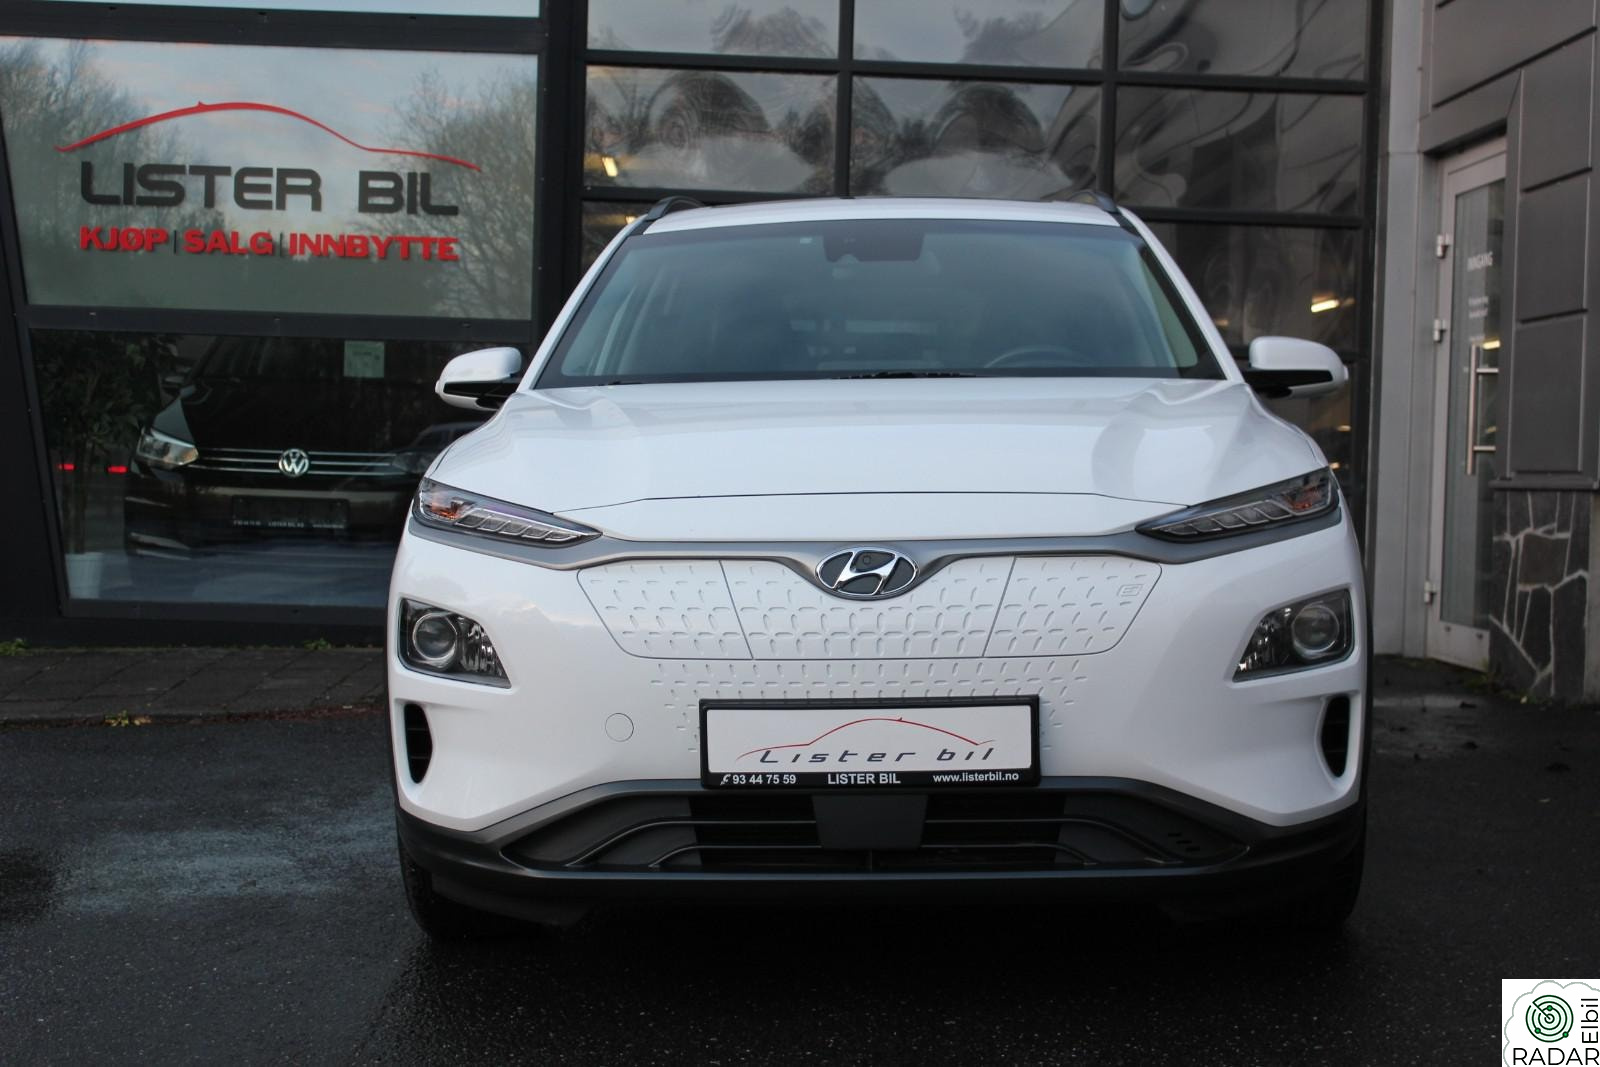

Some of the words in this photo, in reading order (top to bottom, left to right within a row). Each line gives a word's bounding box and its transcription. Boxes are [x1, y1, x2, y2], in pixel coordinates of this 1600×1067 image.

[80, 161, 322, 212] LISTER
[358, 170, 459, 216] BIL
[79, 226, 168, 252] KJØP
[183, 230, 274, 257] SALG
[288, 233, 459, 261] INNBYTTE
[759, 750, 916, 763] Lister
[936, 748, 994, 761] bil
[732, 774, 746, 785] 93
[748, 774, 763, 785] 44
[766, 774, 780, 785] 75
[782, 774, 797, 785] 59
[827, 774, 876, 785] LISTER
[879, 774, 901, 785] BIL
[932, 772, 1019, 782] www.listerbil.no
